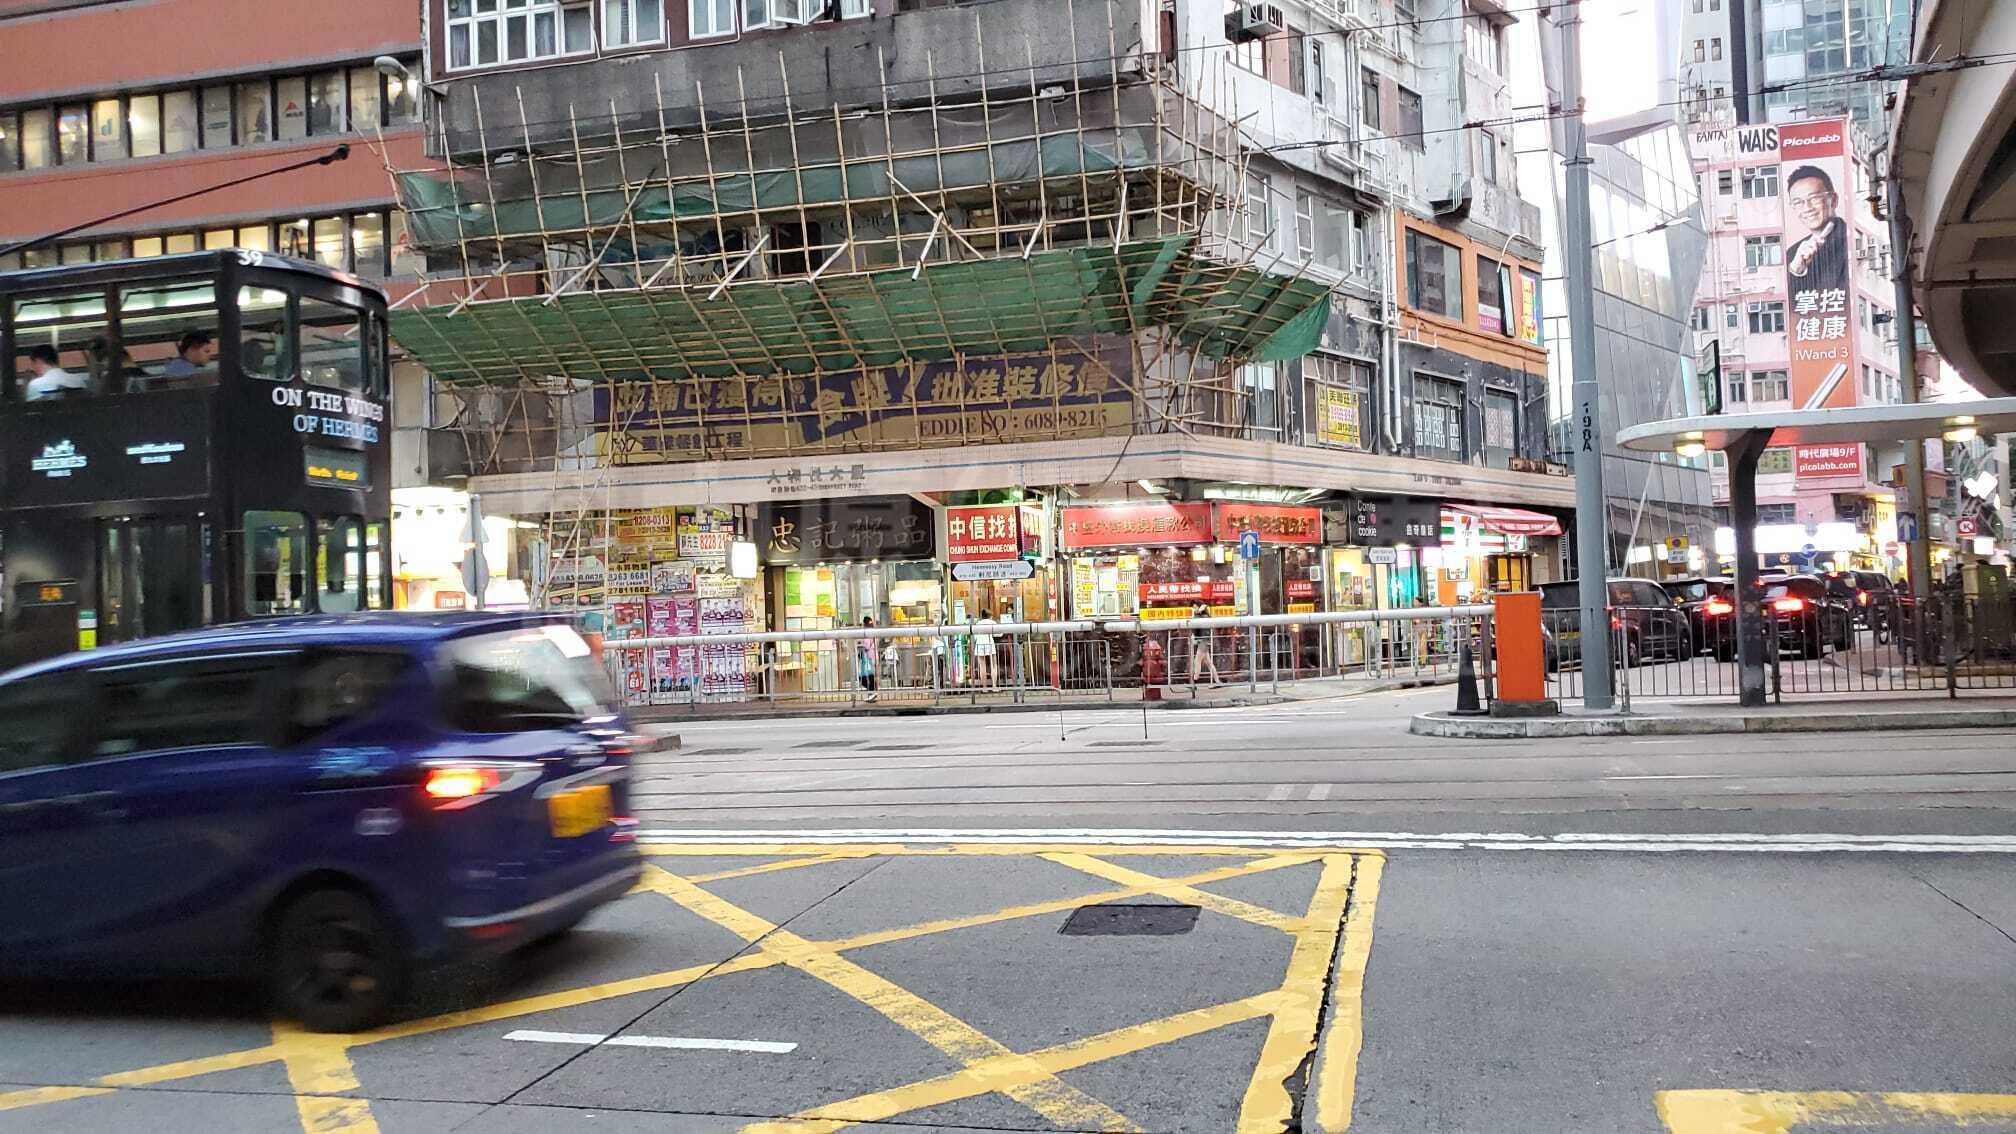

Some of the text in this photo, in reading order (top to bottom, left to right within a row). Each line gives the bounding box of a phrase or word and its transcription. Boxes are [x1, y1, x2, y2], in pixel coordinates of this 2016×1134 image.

[1739, 127, 1778, 153] WAIS
[238, 249, 263, 266] 39
[1795, 288, 1846, 314] 掌控
[1796, 315, 1847, 341] 健康
[1795, 346, 1849, 360] iWand 3
[272, 387, 303, 407] ON
[307, 391, 343, 412] THE
[293, 415, 319, 433] OF
[920, 419, 977, 436] EDDIE
[1799, 461, 1858, 473] picolabb.com
[768, 514, 927, 553] 忠記粥品
